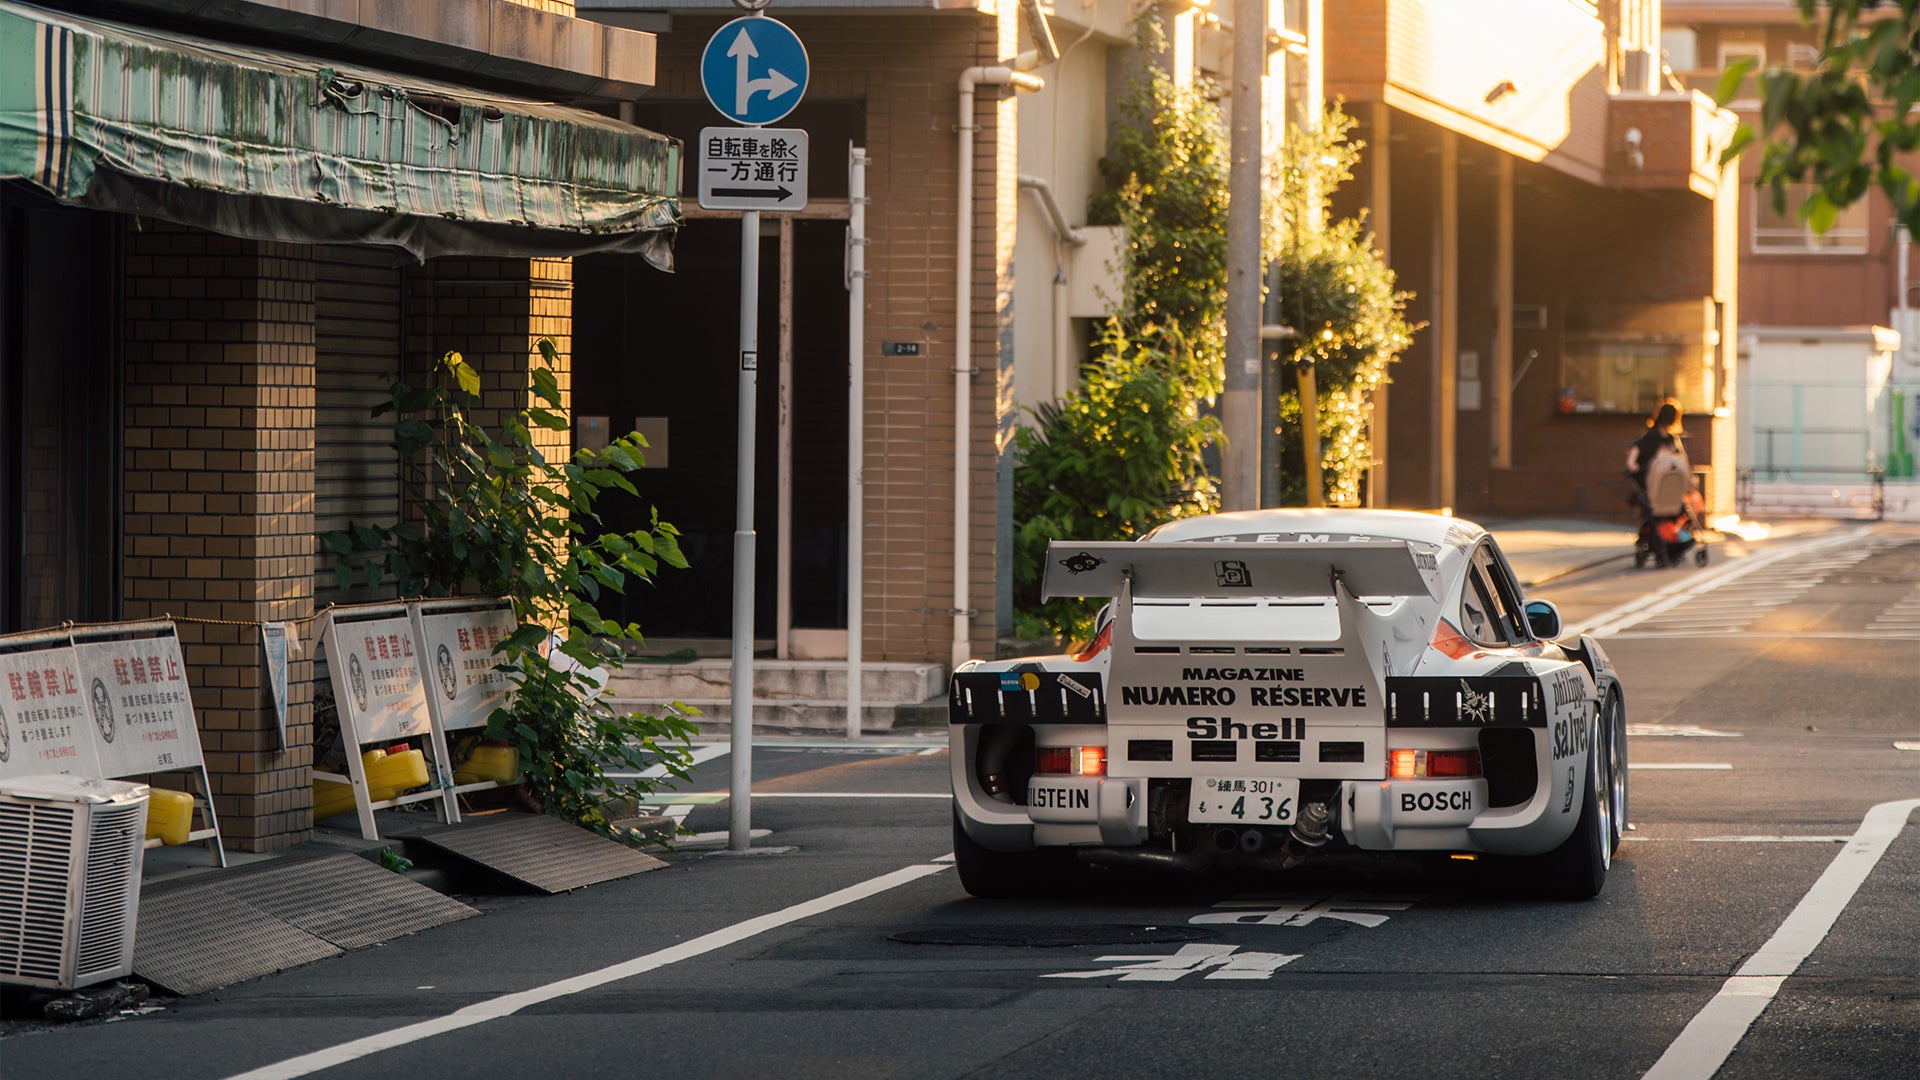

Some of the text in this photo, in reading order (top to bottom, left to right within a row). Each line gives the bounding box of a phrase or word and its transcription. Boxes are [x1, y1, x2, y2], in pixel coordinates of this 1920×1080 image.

[708, 137, 798, 158] 自転車を除く
[707, 161, 798, 182] 一方通行
[1183, 534, 1404, 543] REME
[364, 633, 413, 661] 駐輪禁止
[113, 654, 180, 686] 駐輪禁止
[1182, 668, 1304, 681] MAGAZINE
[8, 666, 78, 701] 駐輪禁止
[1552, 670, 1587, 715] philippe
[1121, 684, 1366, 707] NUMERO RÉSERVÉ
[1187, 717, 1305, 740] Shell
[1028, 787, 1089, 808] ILSTEIN
[1217, 780, 1274, 793] 練馬 301
[1198, 801, 1207, 813] も
[1401, 790, 1472, 813] BOSCH
